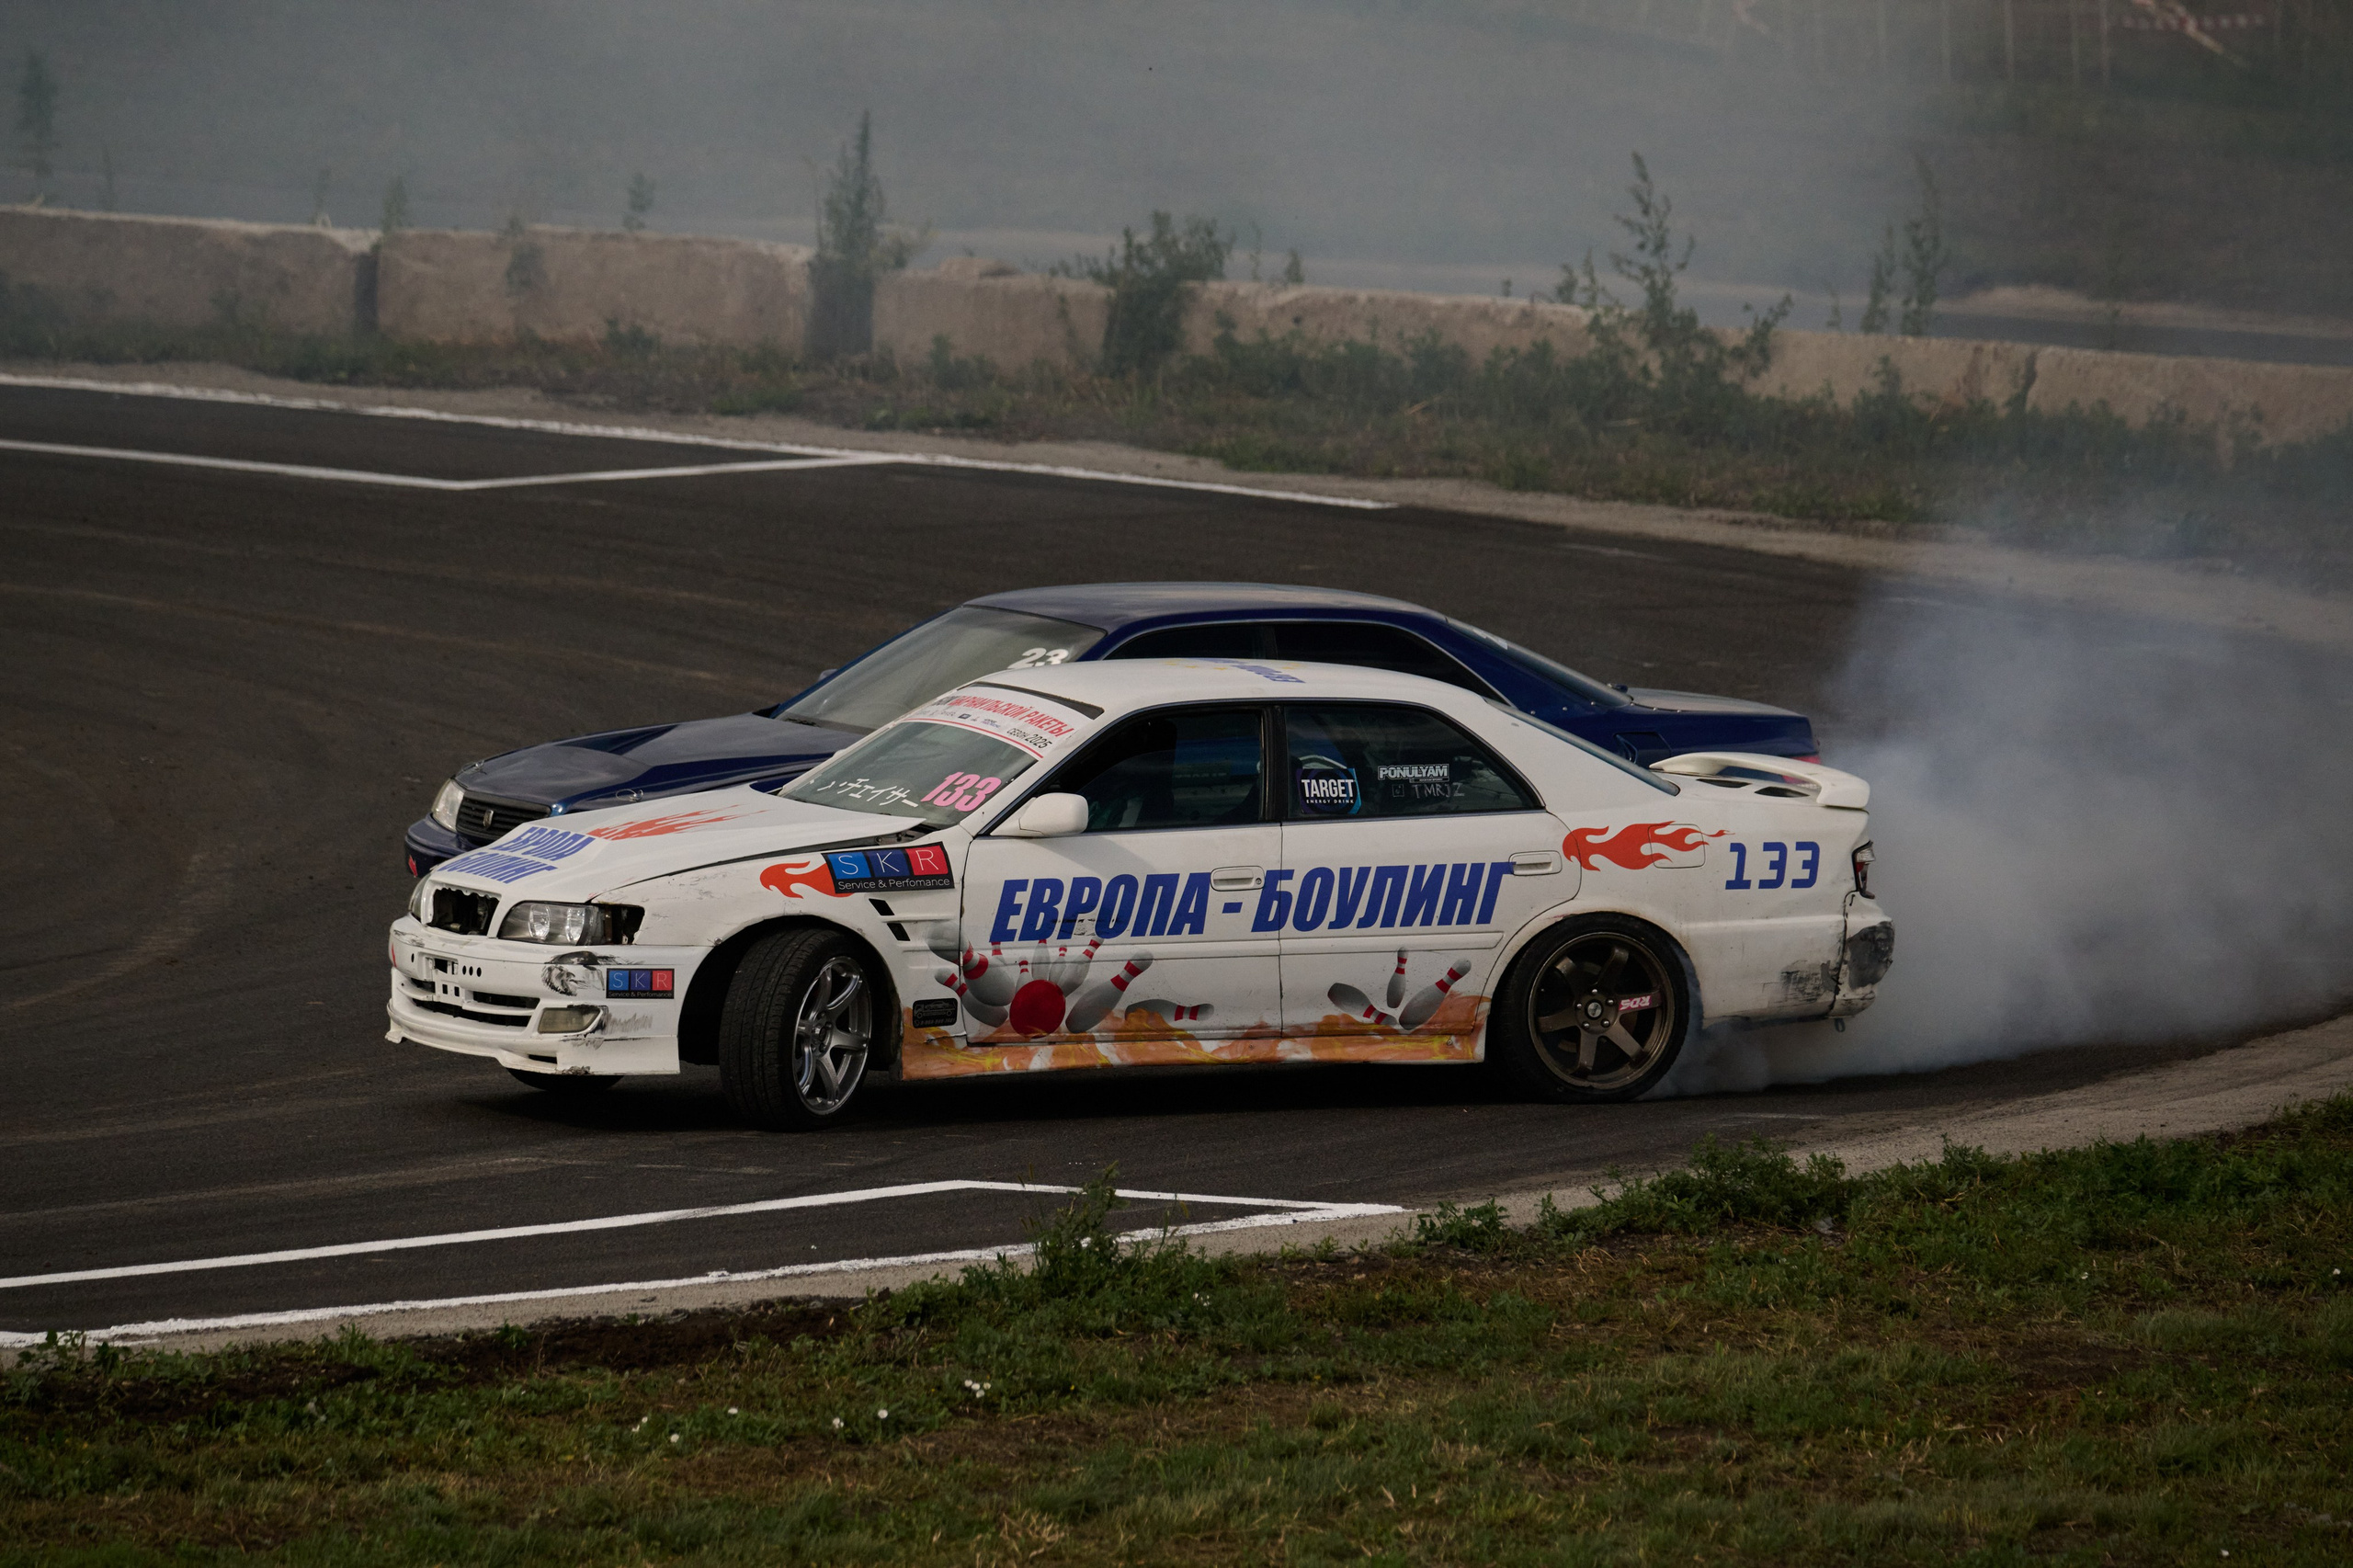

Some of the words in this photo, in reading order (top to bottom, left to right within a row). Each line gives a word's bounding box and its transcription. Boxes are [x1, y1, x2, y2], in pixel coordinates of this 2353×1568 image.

[1007, 647, 1069, 669] 23
[1024, 710, 1074, 737] РАКЕТЫ
[1025, 733, 1052, 749] 2025
[1379, 764, 1449, 779] PONULYAM
[920, 771, 1002, 812] 133
[1301, 778, 1355, 798] TARGET
[489, 826, 597, 861] ЕВРОПА
[837, 849, 939, 875] SKR
[1724, 841, 1821, 890] 133
[837, 881, 876, 890] Service
[878, 880, 887, 889] &
[889, 878, 950, 888] Perfomance
[989, 871, 1214, 943] ЕВРОПА
[1251, 861, 1518, 933] БОУЛИНГ
[612, 972, 668, 988] SKR
[1620, 995, 1651, 1010] RDS
